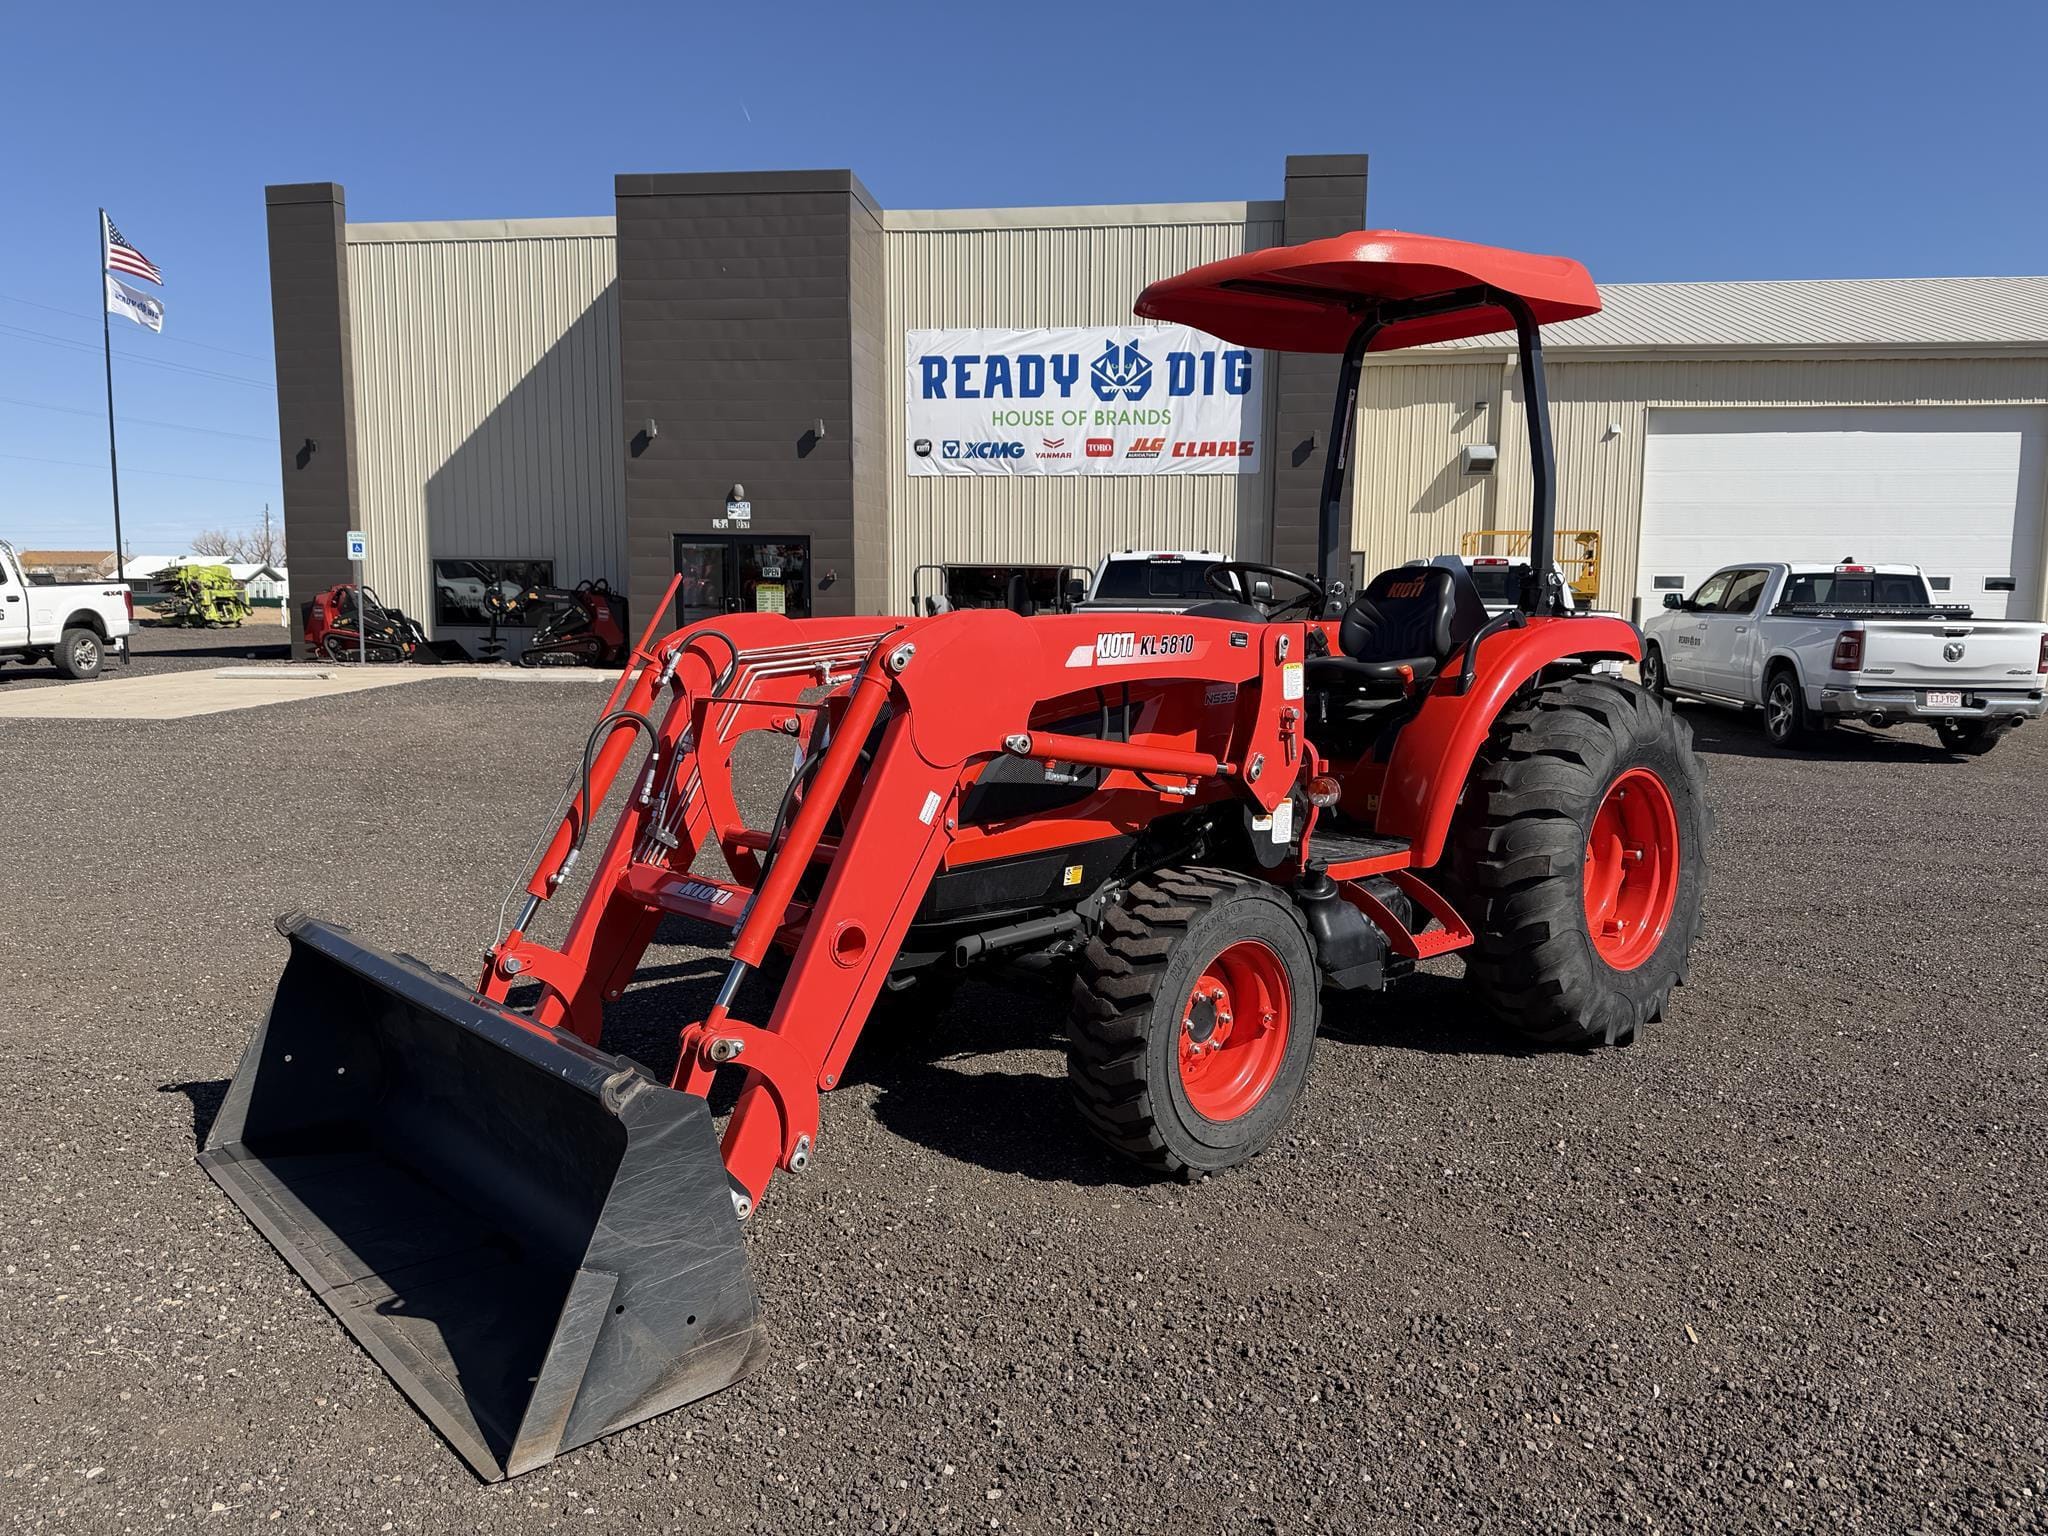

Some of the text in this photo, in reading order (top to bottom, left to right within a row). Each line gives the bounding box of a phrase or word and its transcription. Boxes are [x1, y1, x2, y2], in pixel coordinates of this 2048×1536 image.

[919, 350, 1253, 399] READY DIG
[992, 409, 1172, 427] HOUSE OF BRANDS
[962, 441, 1026, 459] XCMG
[1087, 443, 1112, 452] TORO
[1128, 437, 1166, 451] JLG
[1171, 440, 1255, 458] CLAAS
[763, 568, 780, 577] OPEN
[1387, 579, 1425, 598] KIOTI
[1096, 632, 1135, 659] KIOTI
[679, 882, 735, 905] KIOTI
